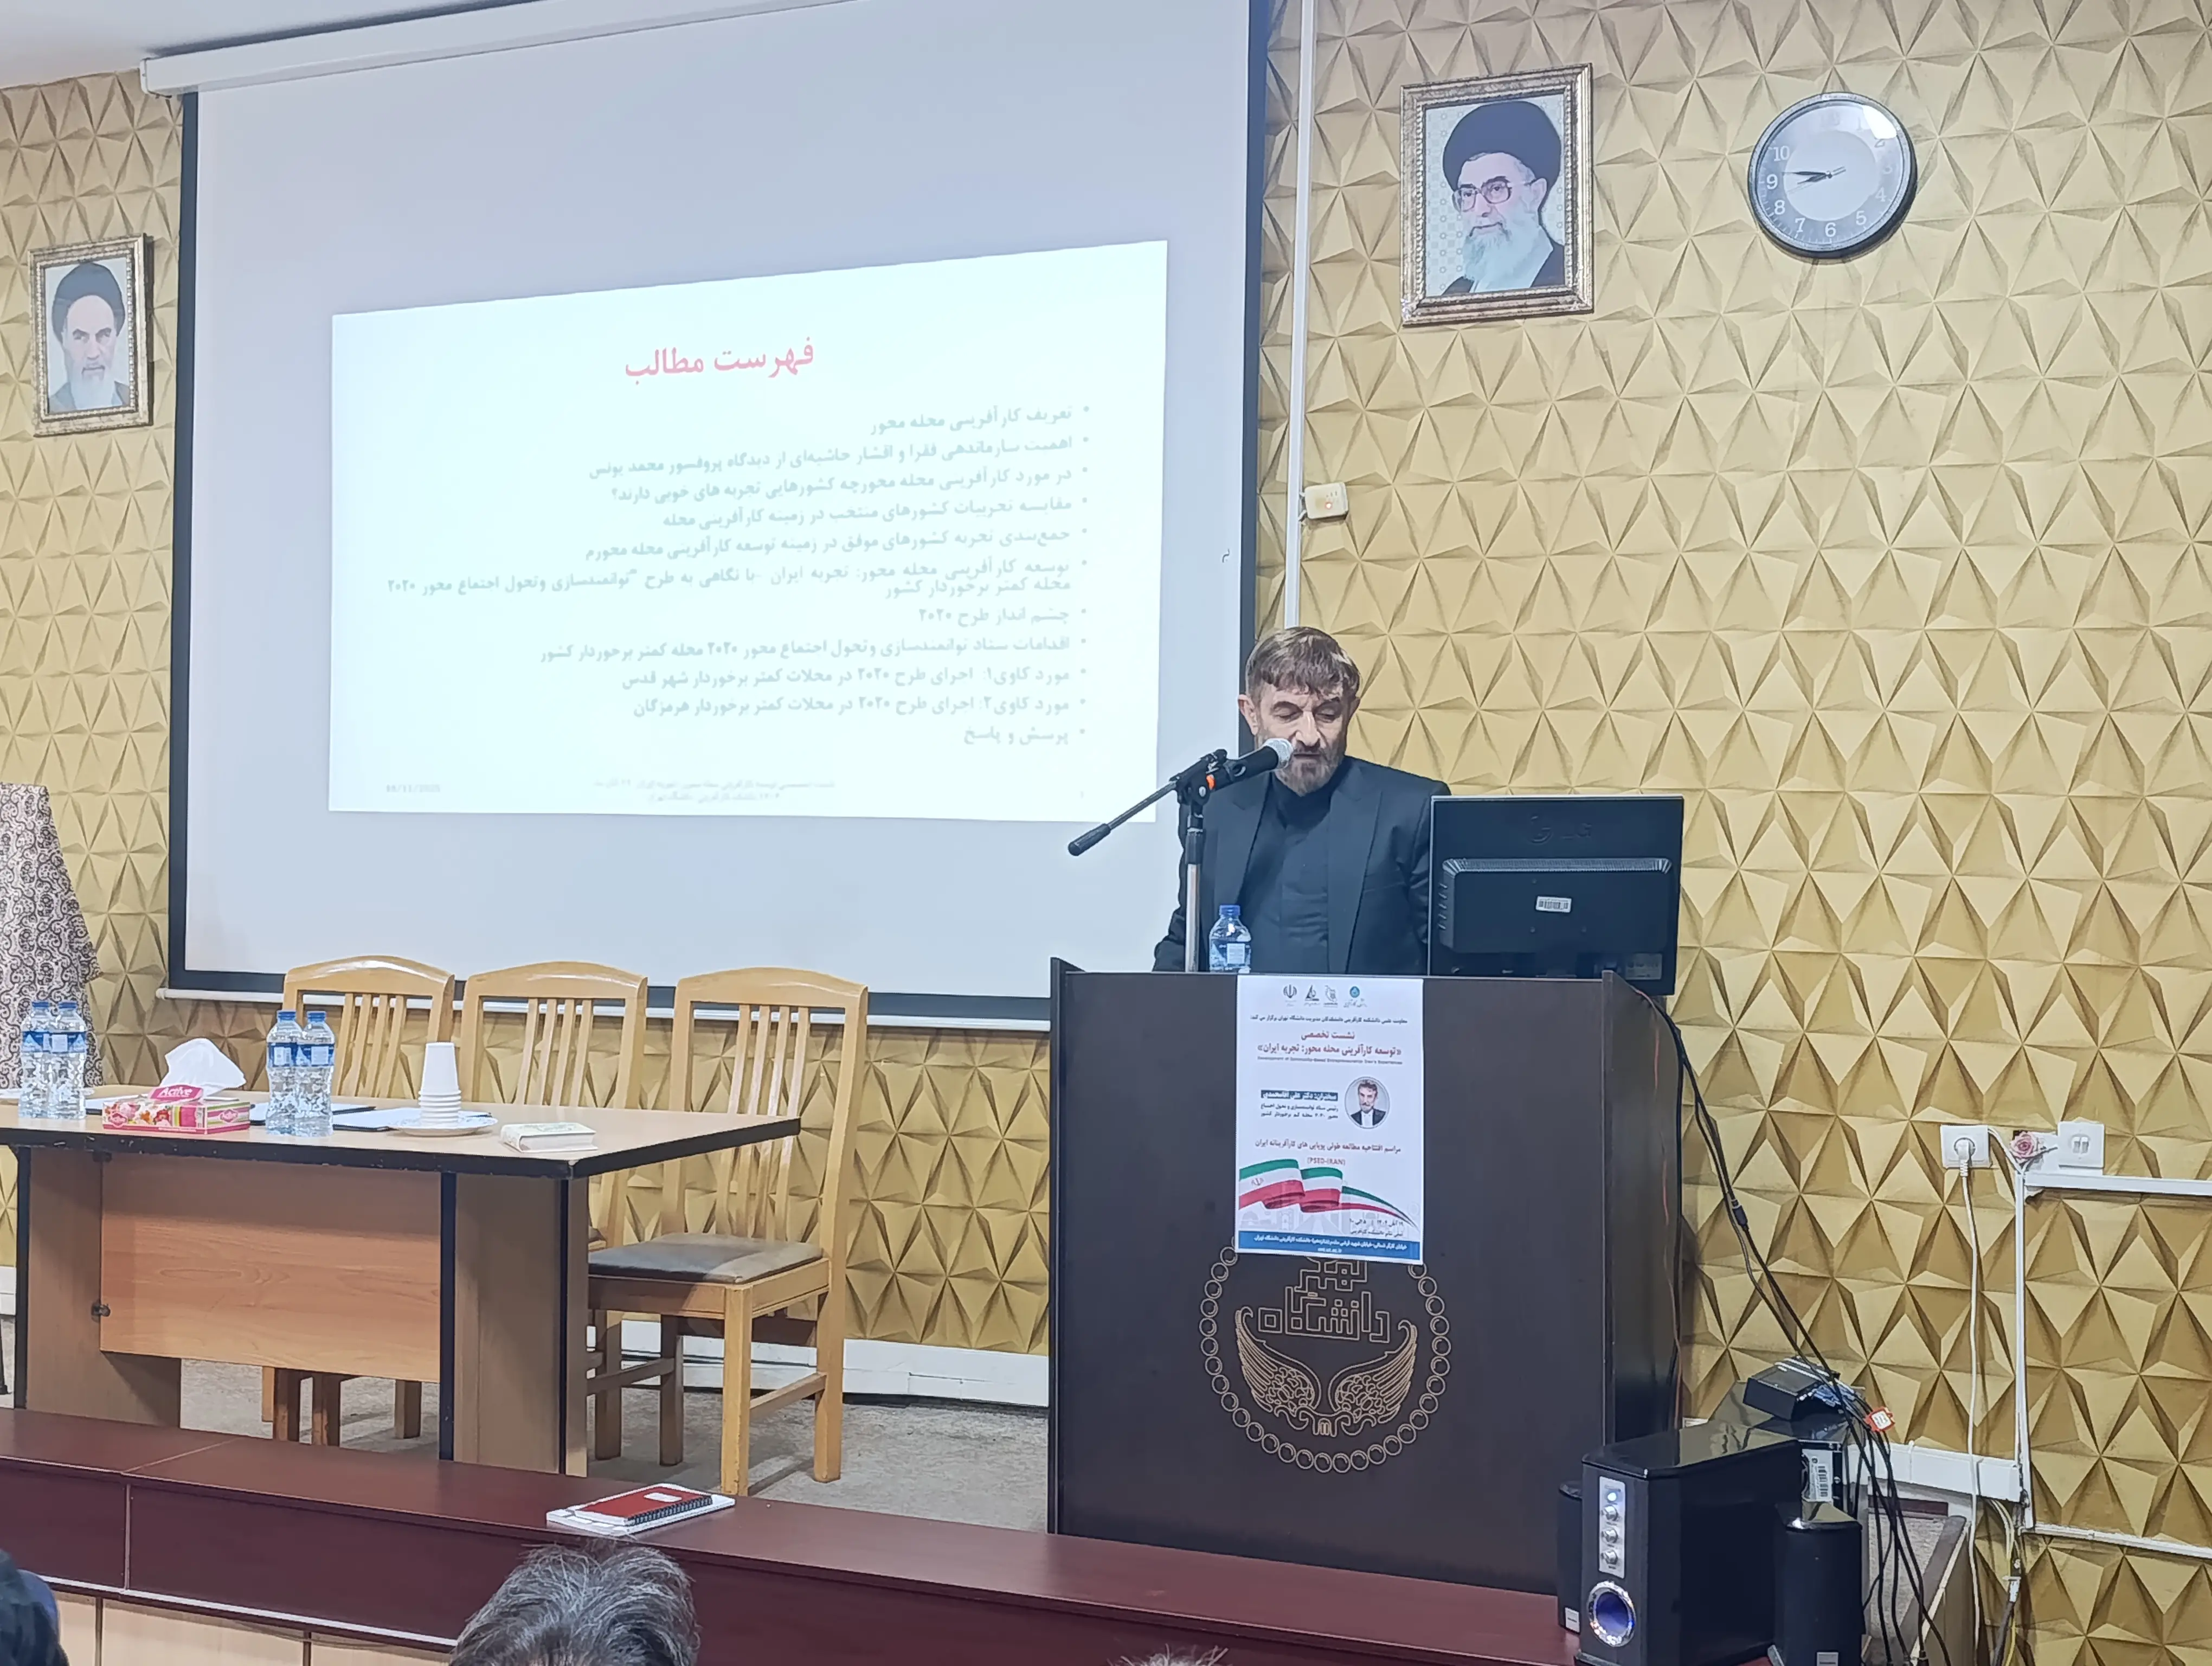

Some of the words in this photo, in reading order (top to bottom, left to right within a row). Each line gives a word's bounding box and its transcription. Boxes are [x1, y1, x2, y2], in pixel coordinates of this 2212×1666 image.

[1773, 145, 1790, 162] 10
[1766, 174, 1778, 190] 9
[1875, 187, 1888, 202] 4
[1773, 200, 1786, 215] 8
[1795, 217, 1806, 233] 7
[1855, 210, 1867, 226] 5
[1824, 222, 1837, 238] 6
[713, 336, 814, 379] فهرست
[625, 347, 705, 386] مطالب
[871, 420, 905, 435] محور
[910, 414, 945, 427] محله
[728, 452, 770, 468] دیدگاه
[899, 450, 905, 464] و
[628, 463, 664, 472] محمد
[669, 457, 722, 475] پروفسور
[900, 473, 934, 486] محله
[1015, 471, 1050, 486] مورد
[1056, 470, 1071, 485] در
[724, 482, 761, 500] تجربه
[663, 514, 696, 526] محله
[810, 510, 824, 525] در
[736, 538, 775, 555] توسعه
[781, 540, 816, 554] زمینه
[823, 538, 837, 553] در
[842, 534, 878, 552] موفق
[883, 530, 949, 551] کشورهای
[631, 542, 664, 555] محله
[771, 566, 802, 585] ایران
[811, 566, 848, 584] تجربه
[903, 562, 937, 575] محله
[1025, 564, 1069, 578] توسعه
[645, 571, 674, 589] طرح
[681, 574, 693, 583] به
[1034, 577, 1071, 590] محله
[422, 582, 452, 596] محور
[886, 579, 923, 599] کشور
[958, 608, 989, 627] طرح
[541, 644, 573, 663] کشور
[671, 643, 703, 656] محله
[743, 645, 776, 659] محور
[787, 669, 832, 682] محلات
[838, 671, 852, 686] در
[895, 668, 925, 687] طرح
[1036, 670, 1069, 685] مورد
[788, 697, 833, 710] محلات
[838, 701, 852, 715] در
[896, 696, 927, 715] طرح
[1035, 700, 1069, 715] مورد
[1008, 733, 1014, 745] و
[1019, 727, 1068, 745] پرسش
[1301, 1029, 1329, 1041] تخصصی
[1331, 1030, 1355, 1040] نشست
[1281, 1043, 1300, 1055] تجربه
[1323, 1044, 1340, 1054] محله
[157, 1087, 193, 1098] Active
